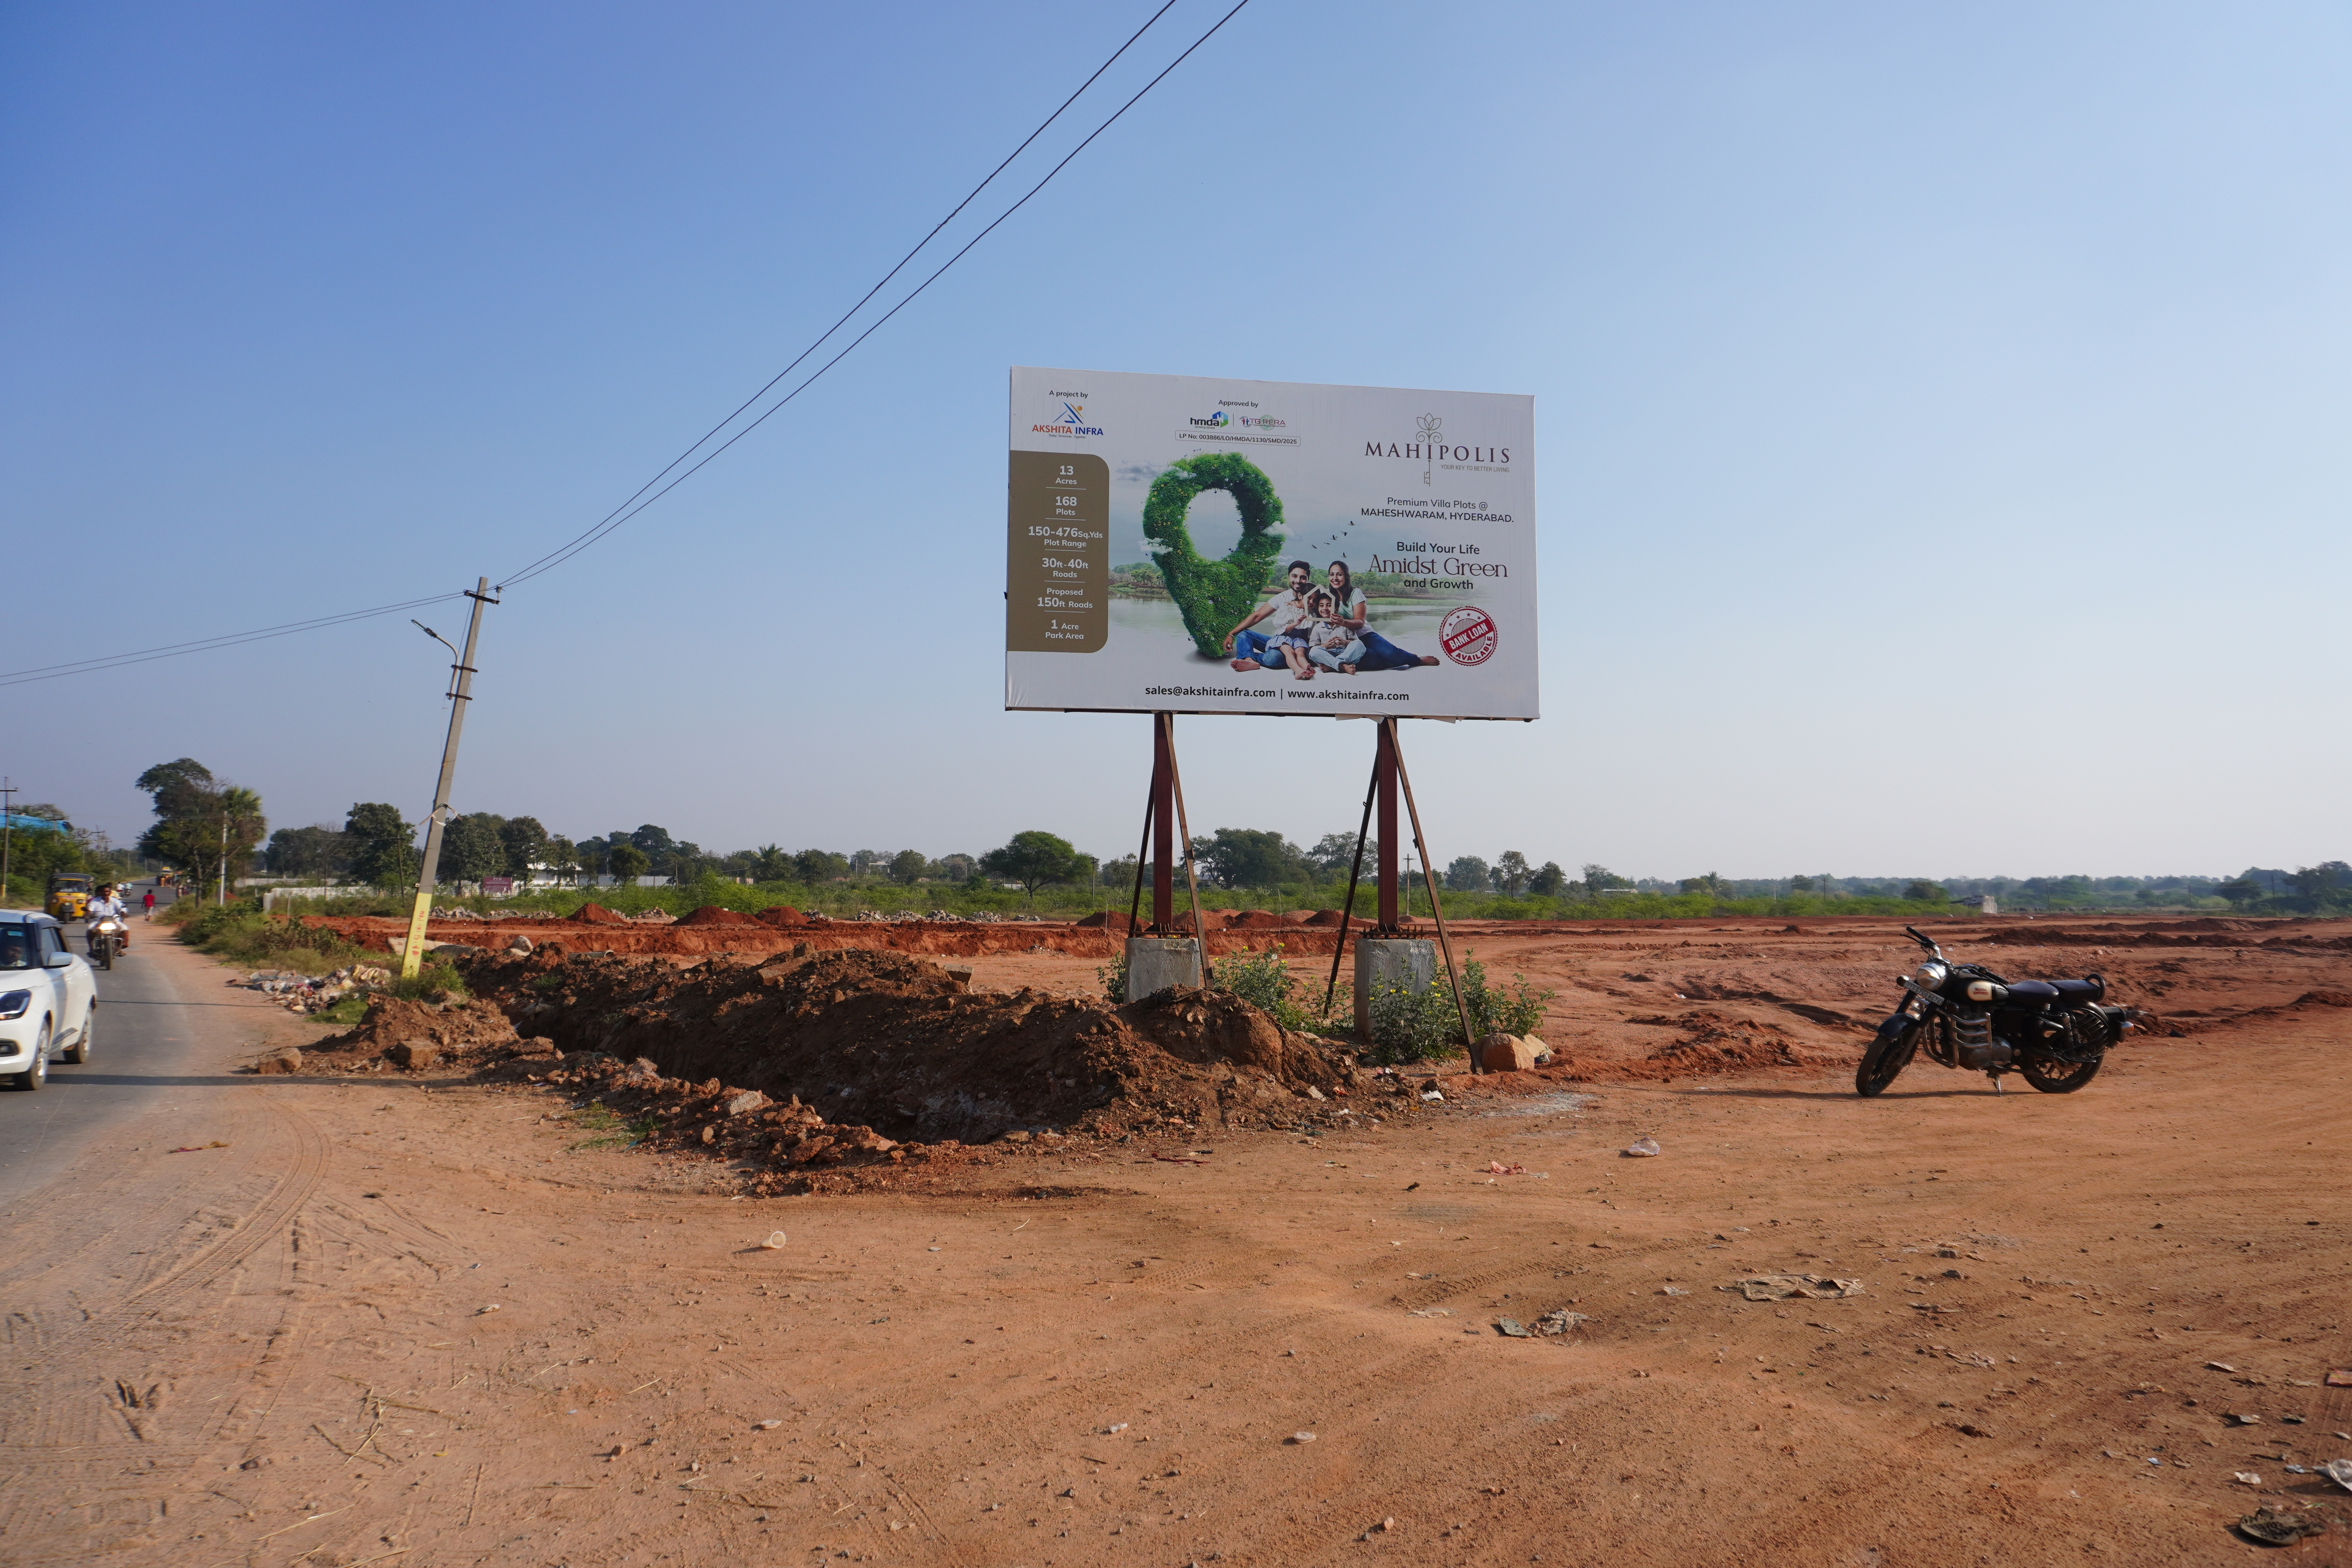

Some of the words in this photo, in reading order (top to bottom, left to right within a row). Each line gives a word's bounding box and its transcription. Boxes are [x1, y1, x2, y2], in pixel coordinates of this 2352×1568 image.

[1190, 417, 1220, 426] hmda
[1032, 425, 1072, 434] AKSHITA
[1075, 427, 1103, 435] INFRA
[1199, 434, 1297, 444] 003886/LO/HMDA/1130/SMD/2025
[1365, 441, 1510, 463] MAHIPOLIS
[1060, 465, 1074, 475] 13
[1055, 496, 1077, 506] 168
[1387, 497, 1428, 507] Premium
[1431, 499, 1450, 508] Villa
[1454, 500, 1476, 509] Plots
[1479, 502, 1488, 511] @
[1361, 508, 1447, 521] MAHESHWARAM,
[1450, 512, 1514, 523] HYDERABAD.
[1062, 540, 1087, 548] Range
[1397, 541, 1426, 552] Build
[1429, 543, 1456, 554] Your
[1459, 544, 1480, 554] Life
[1368, 554, 1438, 574] Amidst
[1444, 557, 1508, 577] Green
[1404, 578, 1426, 588] and
[1430, 579, 1474, 590] Growth
[1047, 588, 1083, 596] Proposed
[1037, 597, 1065, 608] 150ft
[1051, 619, 1058, 629] 1
[1448, 632, 1470, 650] BANK
[1468, 622, 1488, 639] LOAN
[1455, 636, 1492, 661] AVAILABLE
[1145, 686, 1276, 697] sales@akshitainfra.com
[1287, 690, 1409, 701] www.akshitainfra.com
